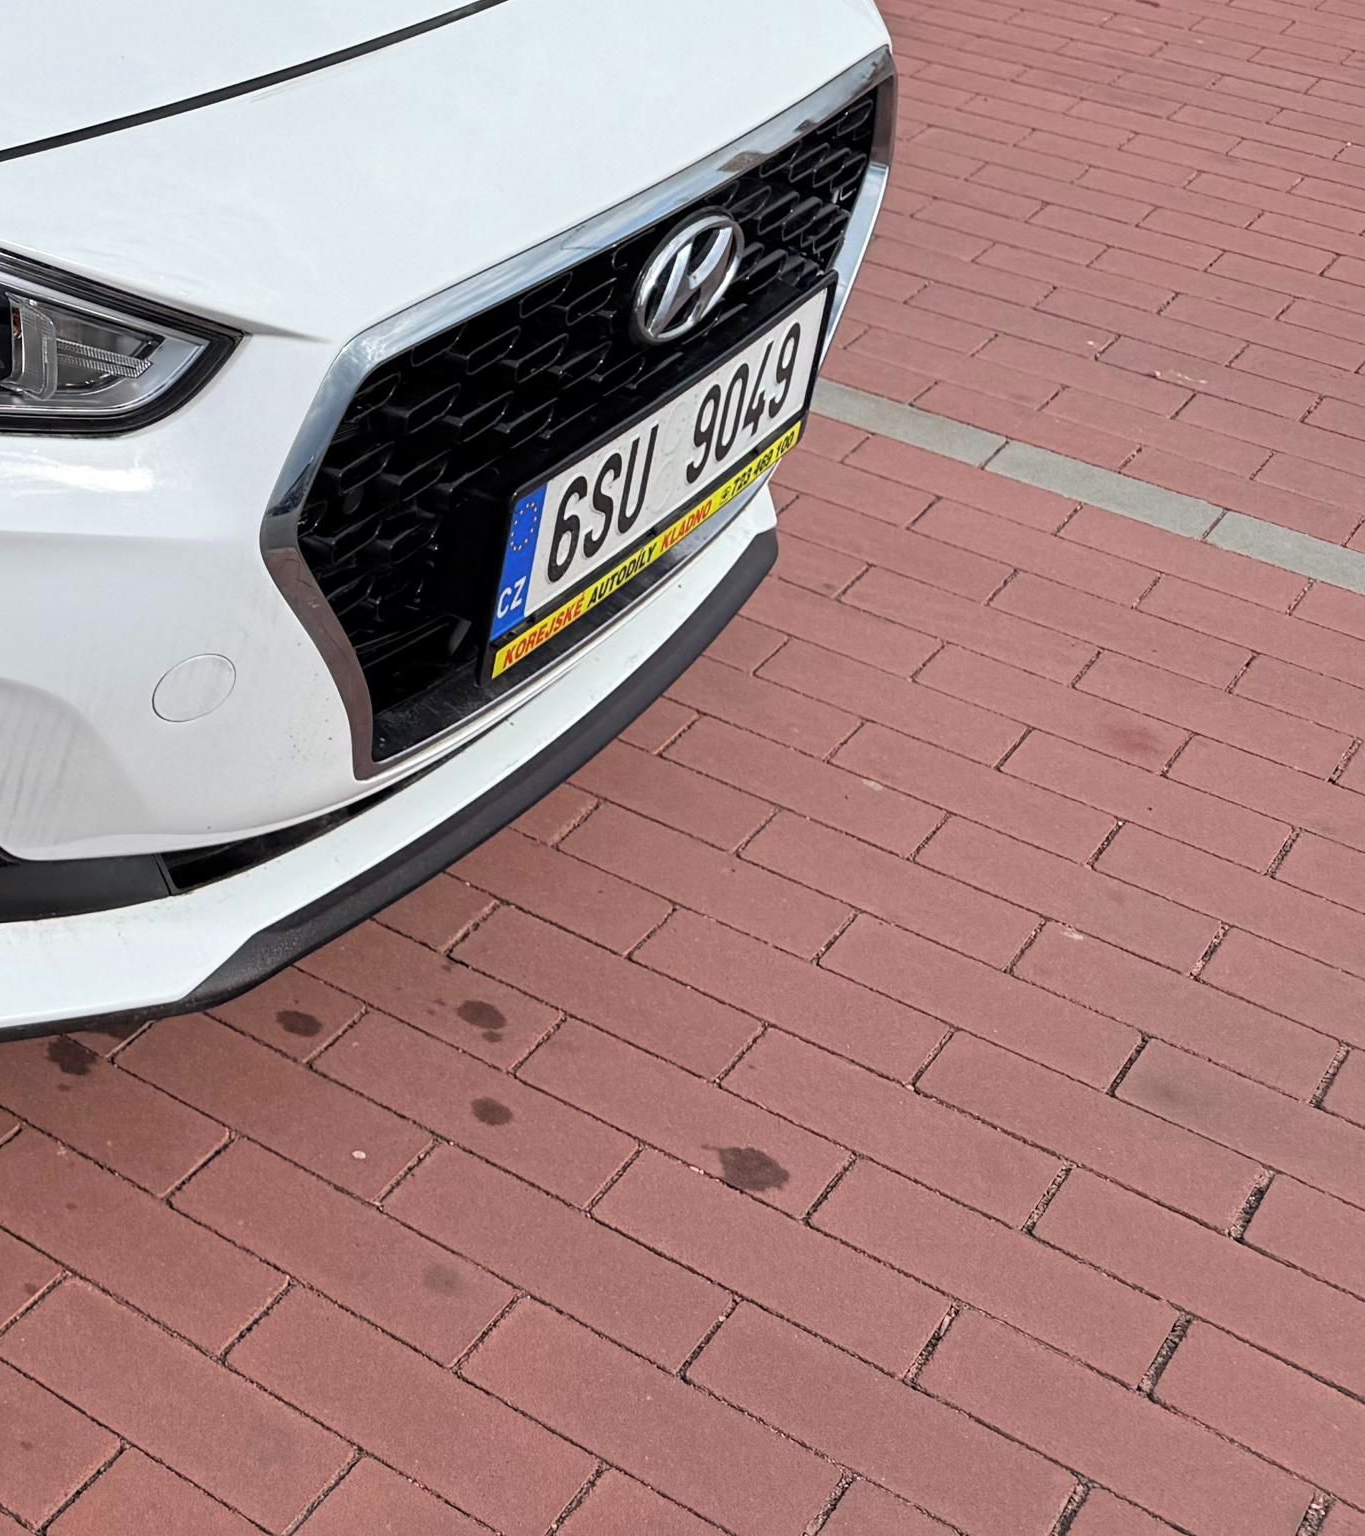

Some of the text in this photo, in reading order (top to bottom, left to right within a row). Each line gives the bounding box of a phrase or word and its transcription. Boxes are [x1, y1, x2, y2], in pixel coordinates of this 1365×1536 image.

[547, 322, 801, 584] 6SU 9049
[497, 575, 527, 619] CZ
[502, 591, 586, 669] KOREJSKÉ
[587, 543, 657, 607] AUTODÍLY
[660, 500, 712, 553] KLADNO
